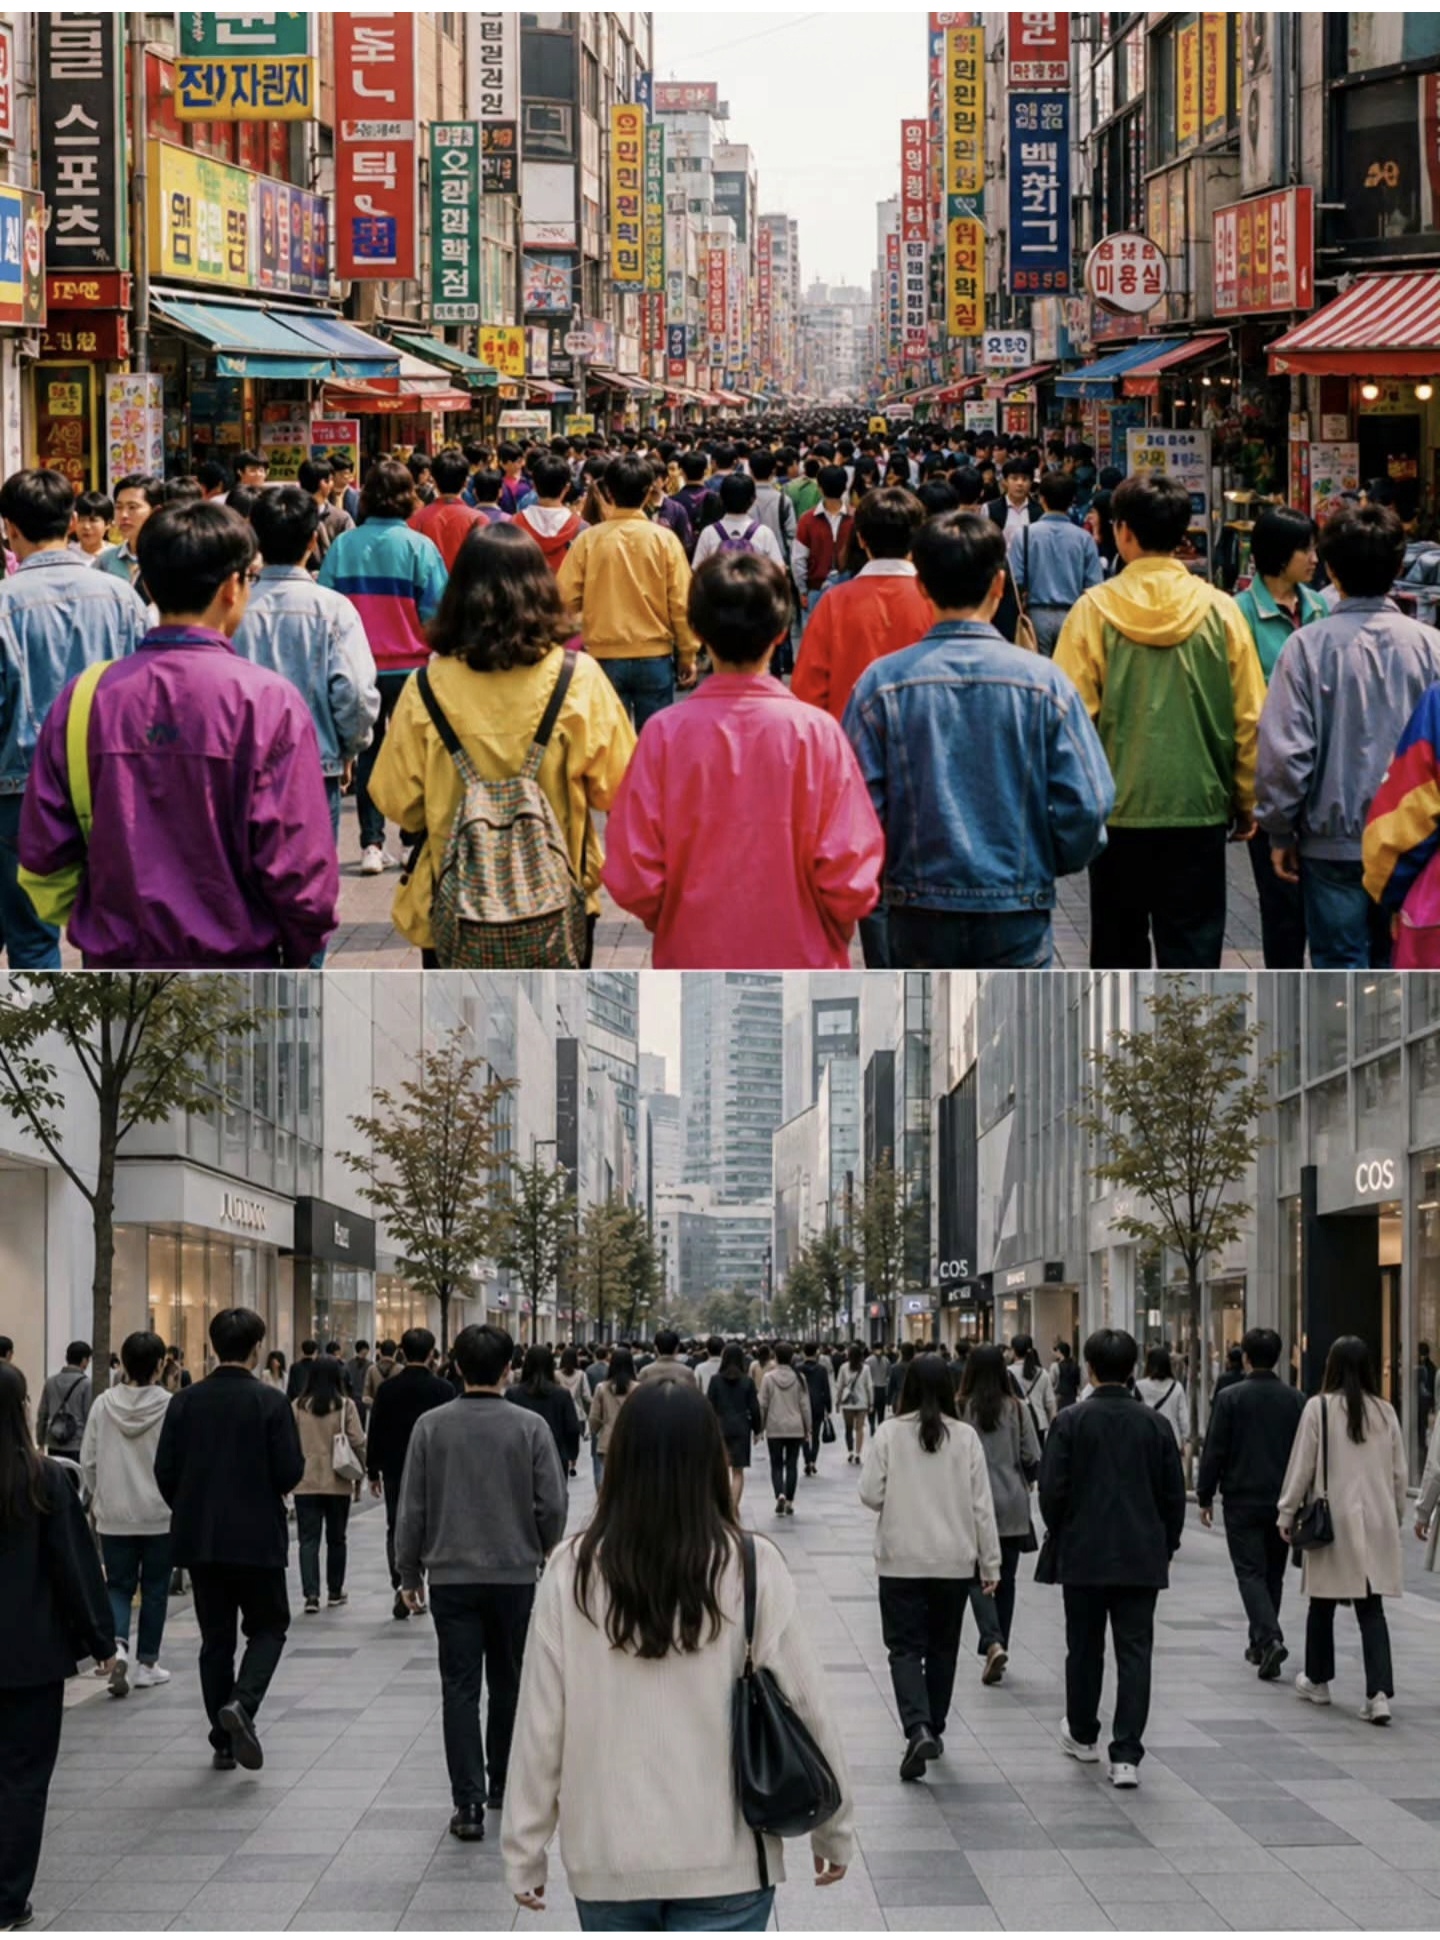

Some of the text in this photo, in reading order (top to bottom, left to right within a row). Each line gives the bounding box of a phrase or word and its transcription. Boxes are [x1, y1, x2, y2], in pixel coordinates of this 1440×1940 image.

[54, 104, 101, 246] 스포츠
[1096, 264, 1161, 295] 미용실
[1356, 1158, 1394, 1193] COS
[940, 1259, 968, 1278] COS
